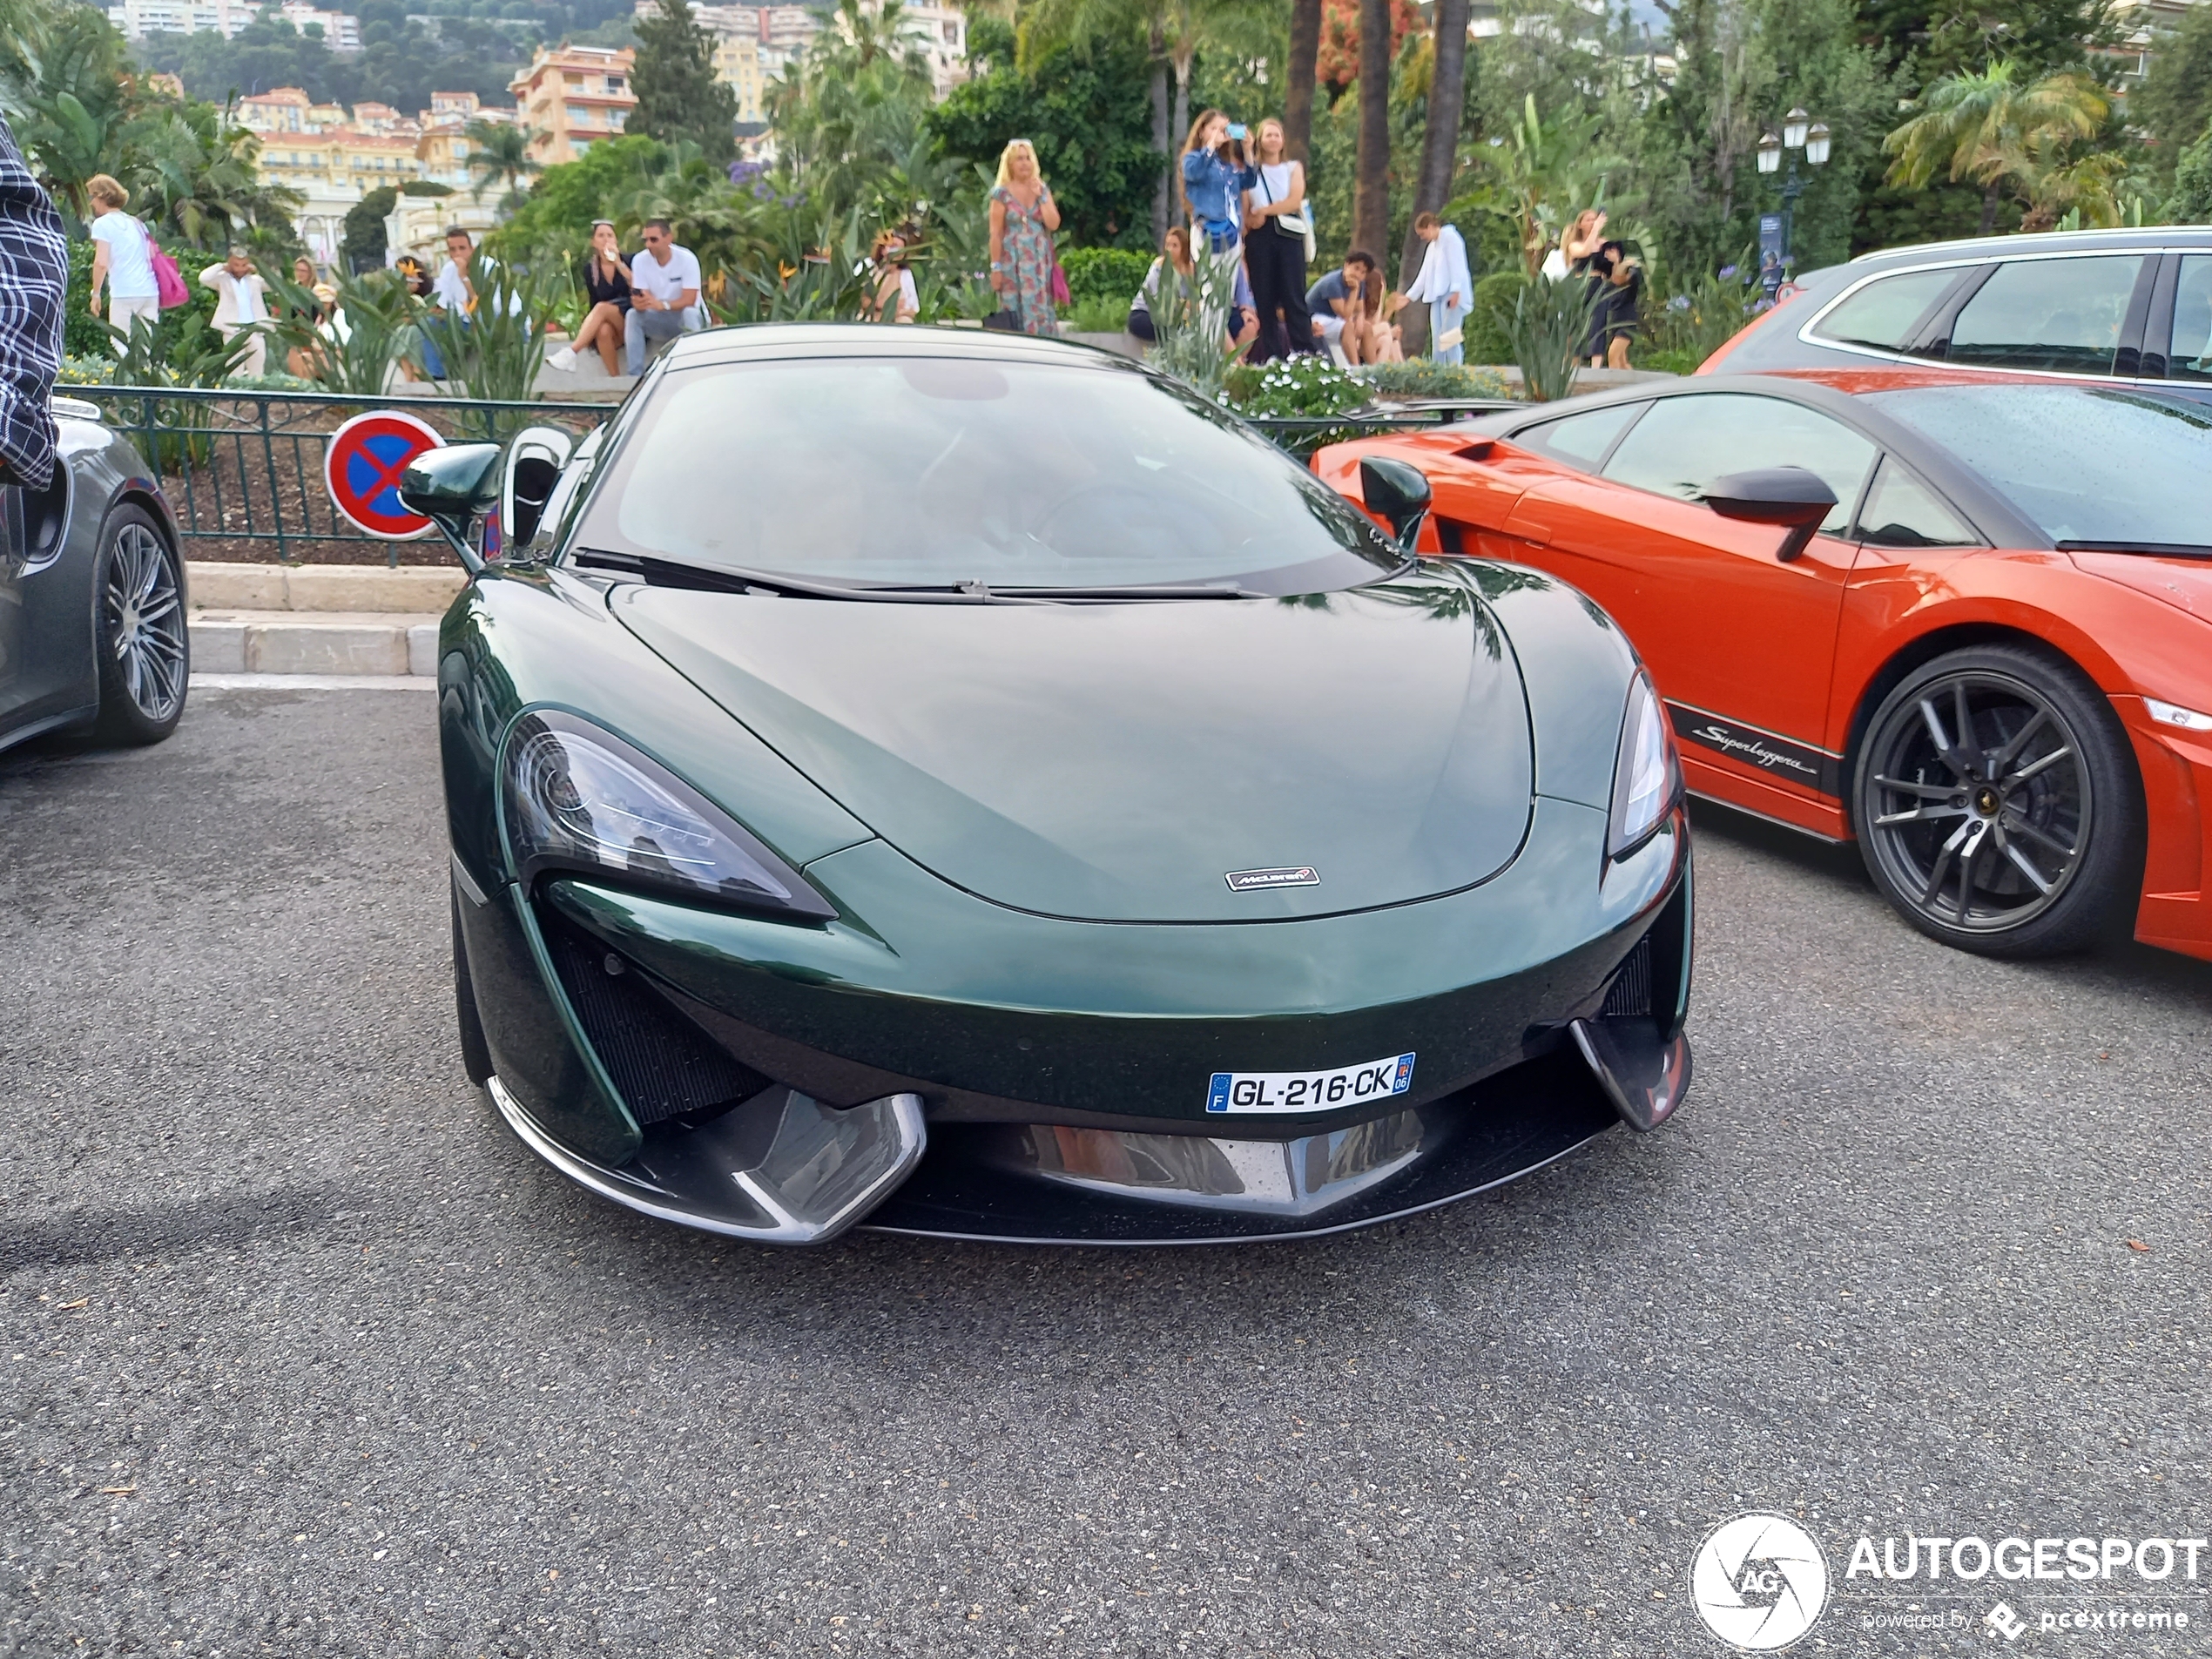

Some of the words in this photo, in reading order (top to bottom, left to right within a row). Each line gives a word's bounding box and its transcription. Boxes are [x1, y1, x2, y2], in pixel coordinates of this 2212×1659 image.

[1692, 725, 1817, 774] Superleggera
[1232, 1064, 1393, 1106] GL-216-CK
[1395, 1077, 1407, 1089] 06
[1213, 1095, 1224, 1107] F
